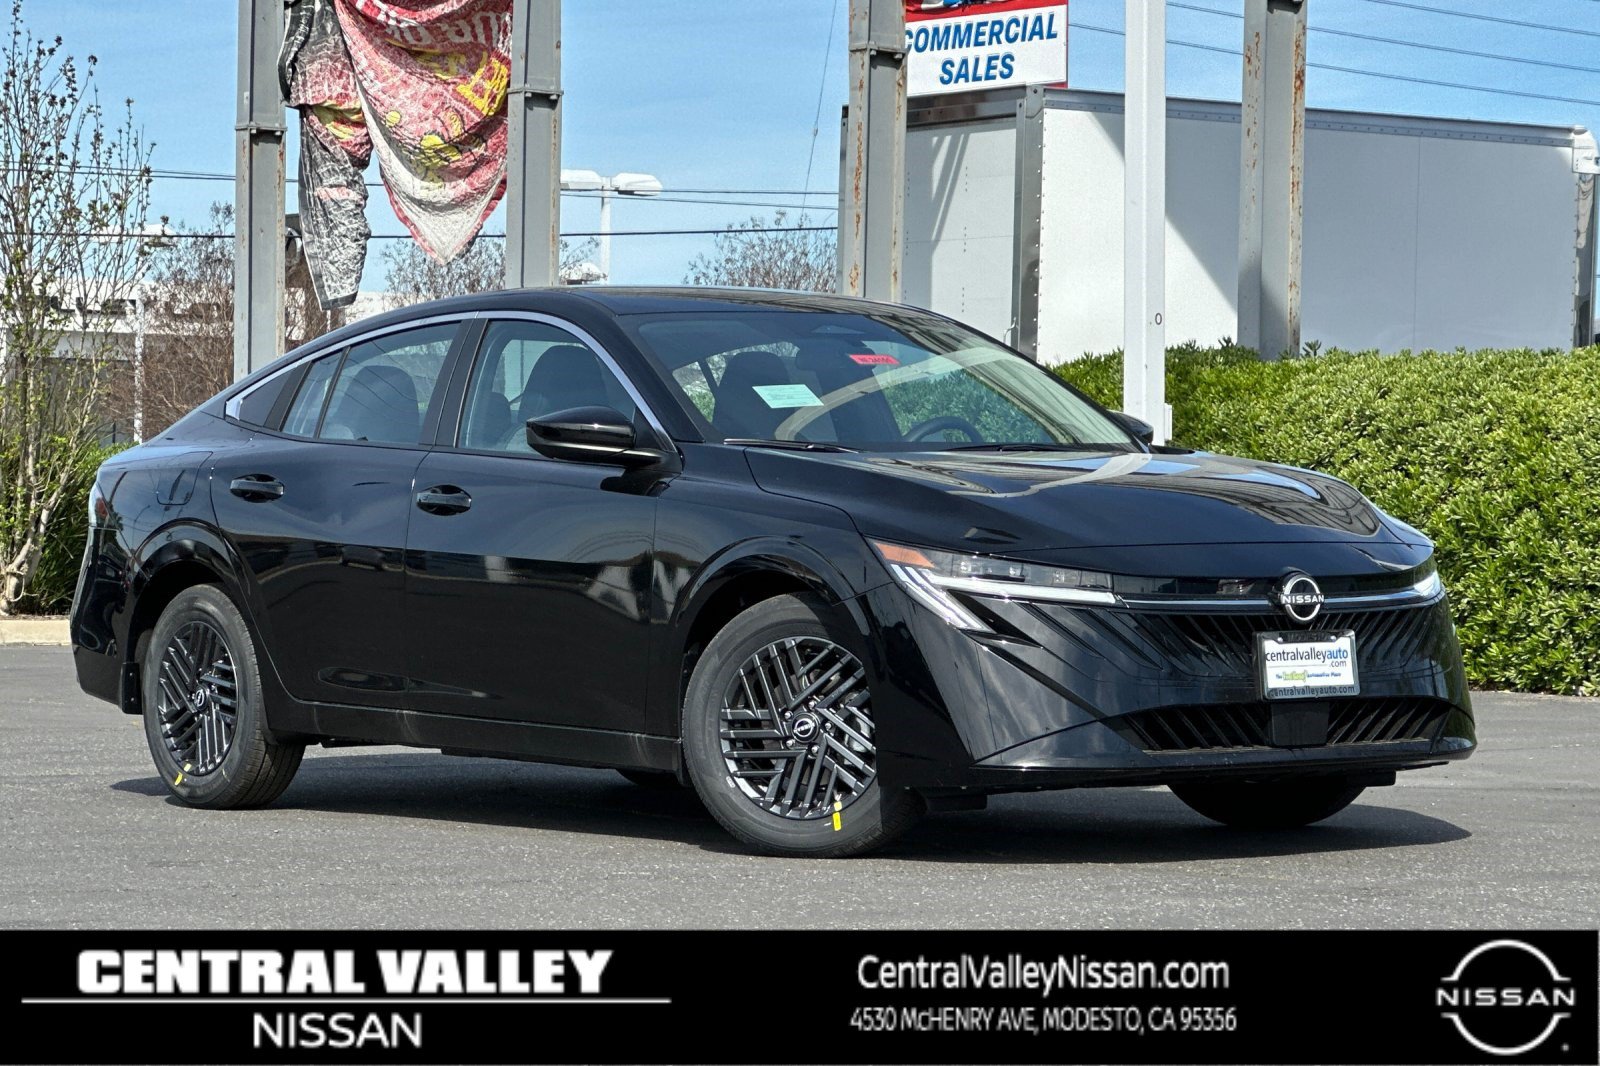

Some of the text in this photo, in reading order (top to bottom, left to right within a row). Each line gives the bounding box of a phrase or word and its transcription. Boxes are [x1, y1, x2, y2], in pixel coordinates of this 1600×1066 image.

[939, 52, 1015, 85] SALES
[1281, 594, 1325, 604] NISSAN
[1265, 646, 1348, 663] centralvalleyauto
